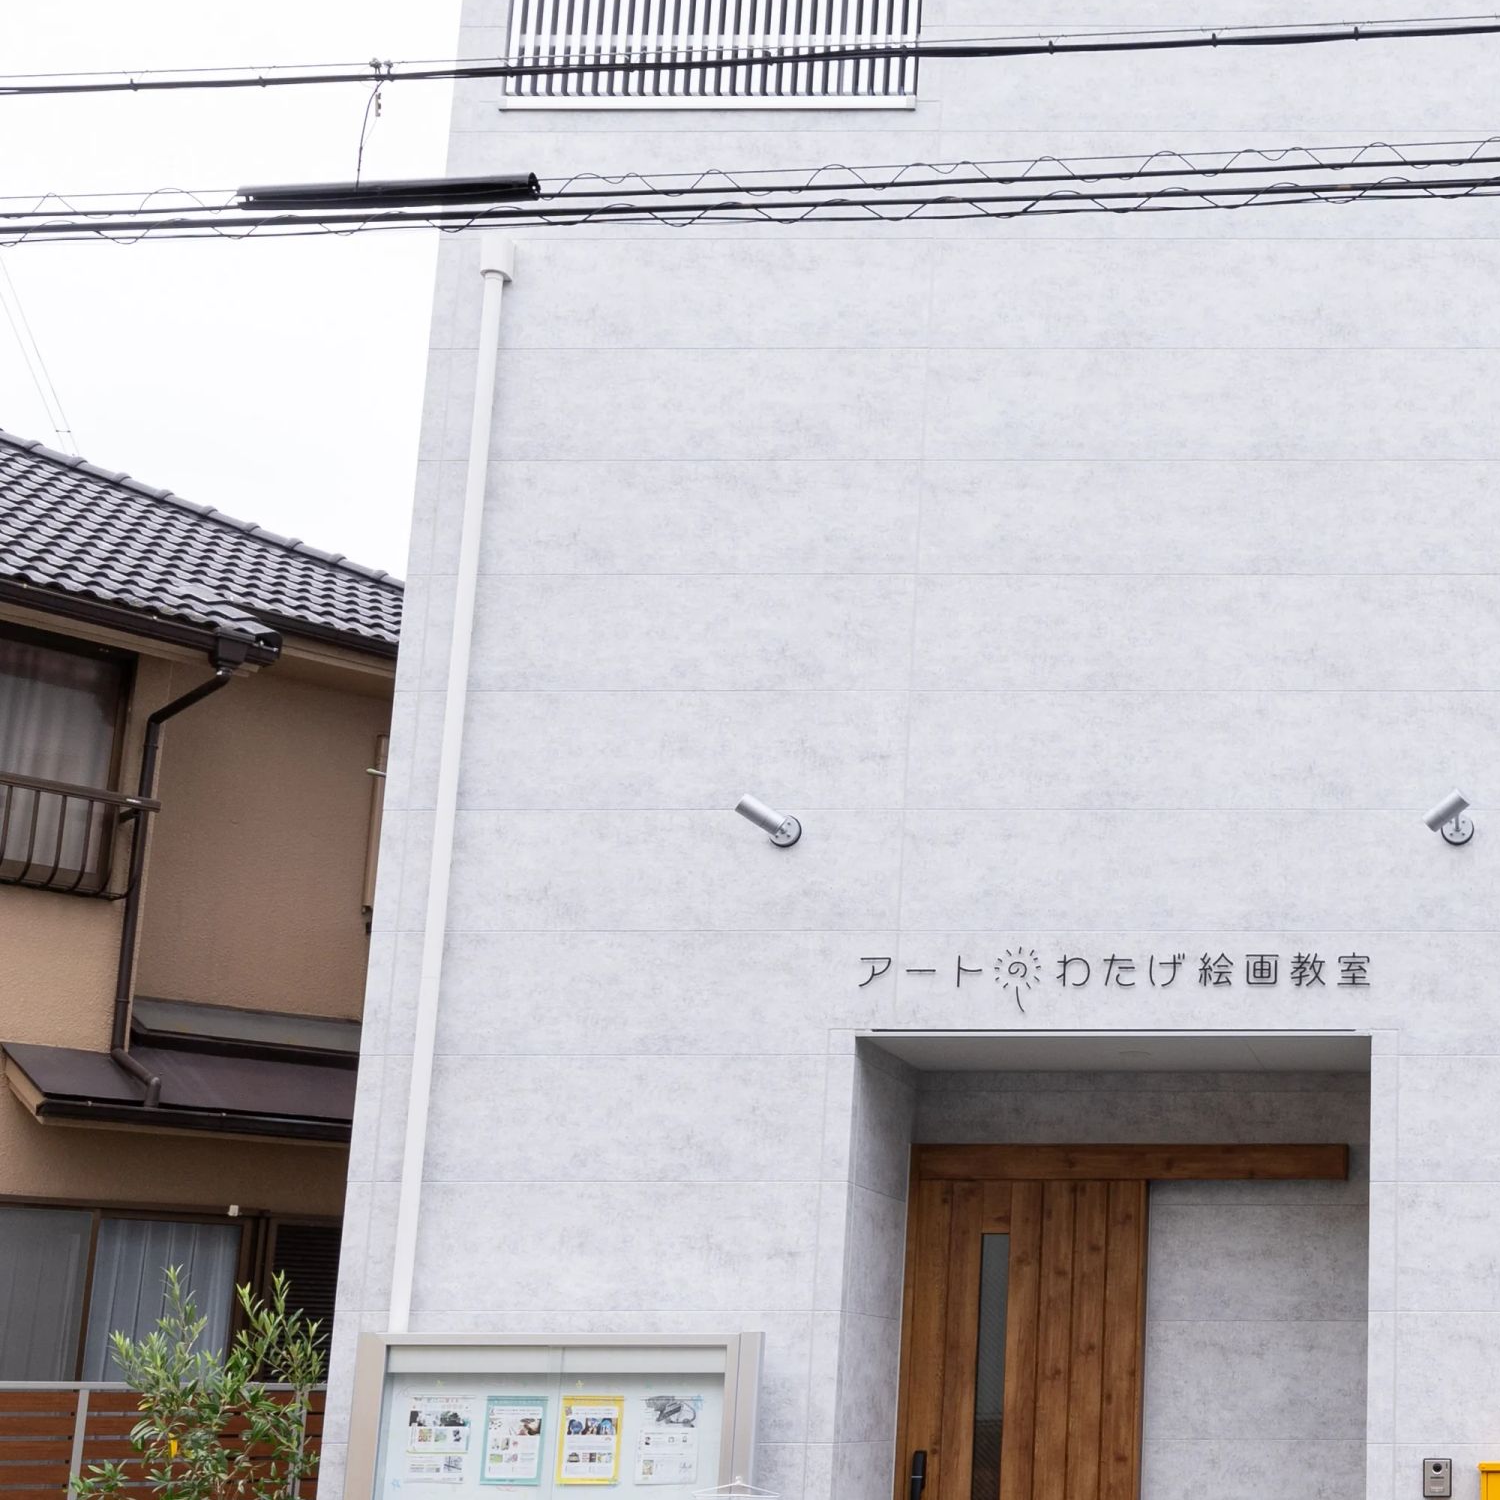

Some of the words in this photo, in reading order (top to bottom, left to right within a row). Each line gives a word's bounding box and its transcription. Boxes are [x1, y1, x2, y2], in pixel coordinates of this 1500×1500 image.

[858, 949, 1372, 989] アートのわたげ絵画教室
